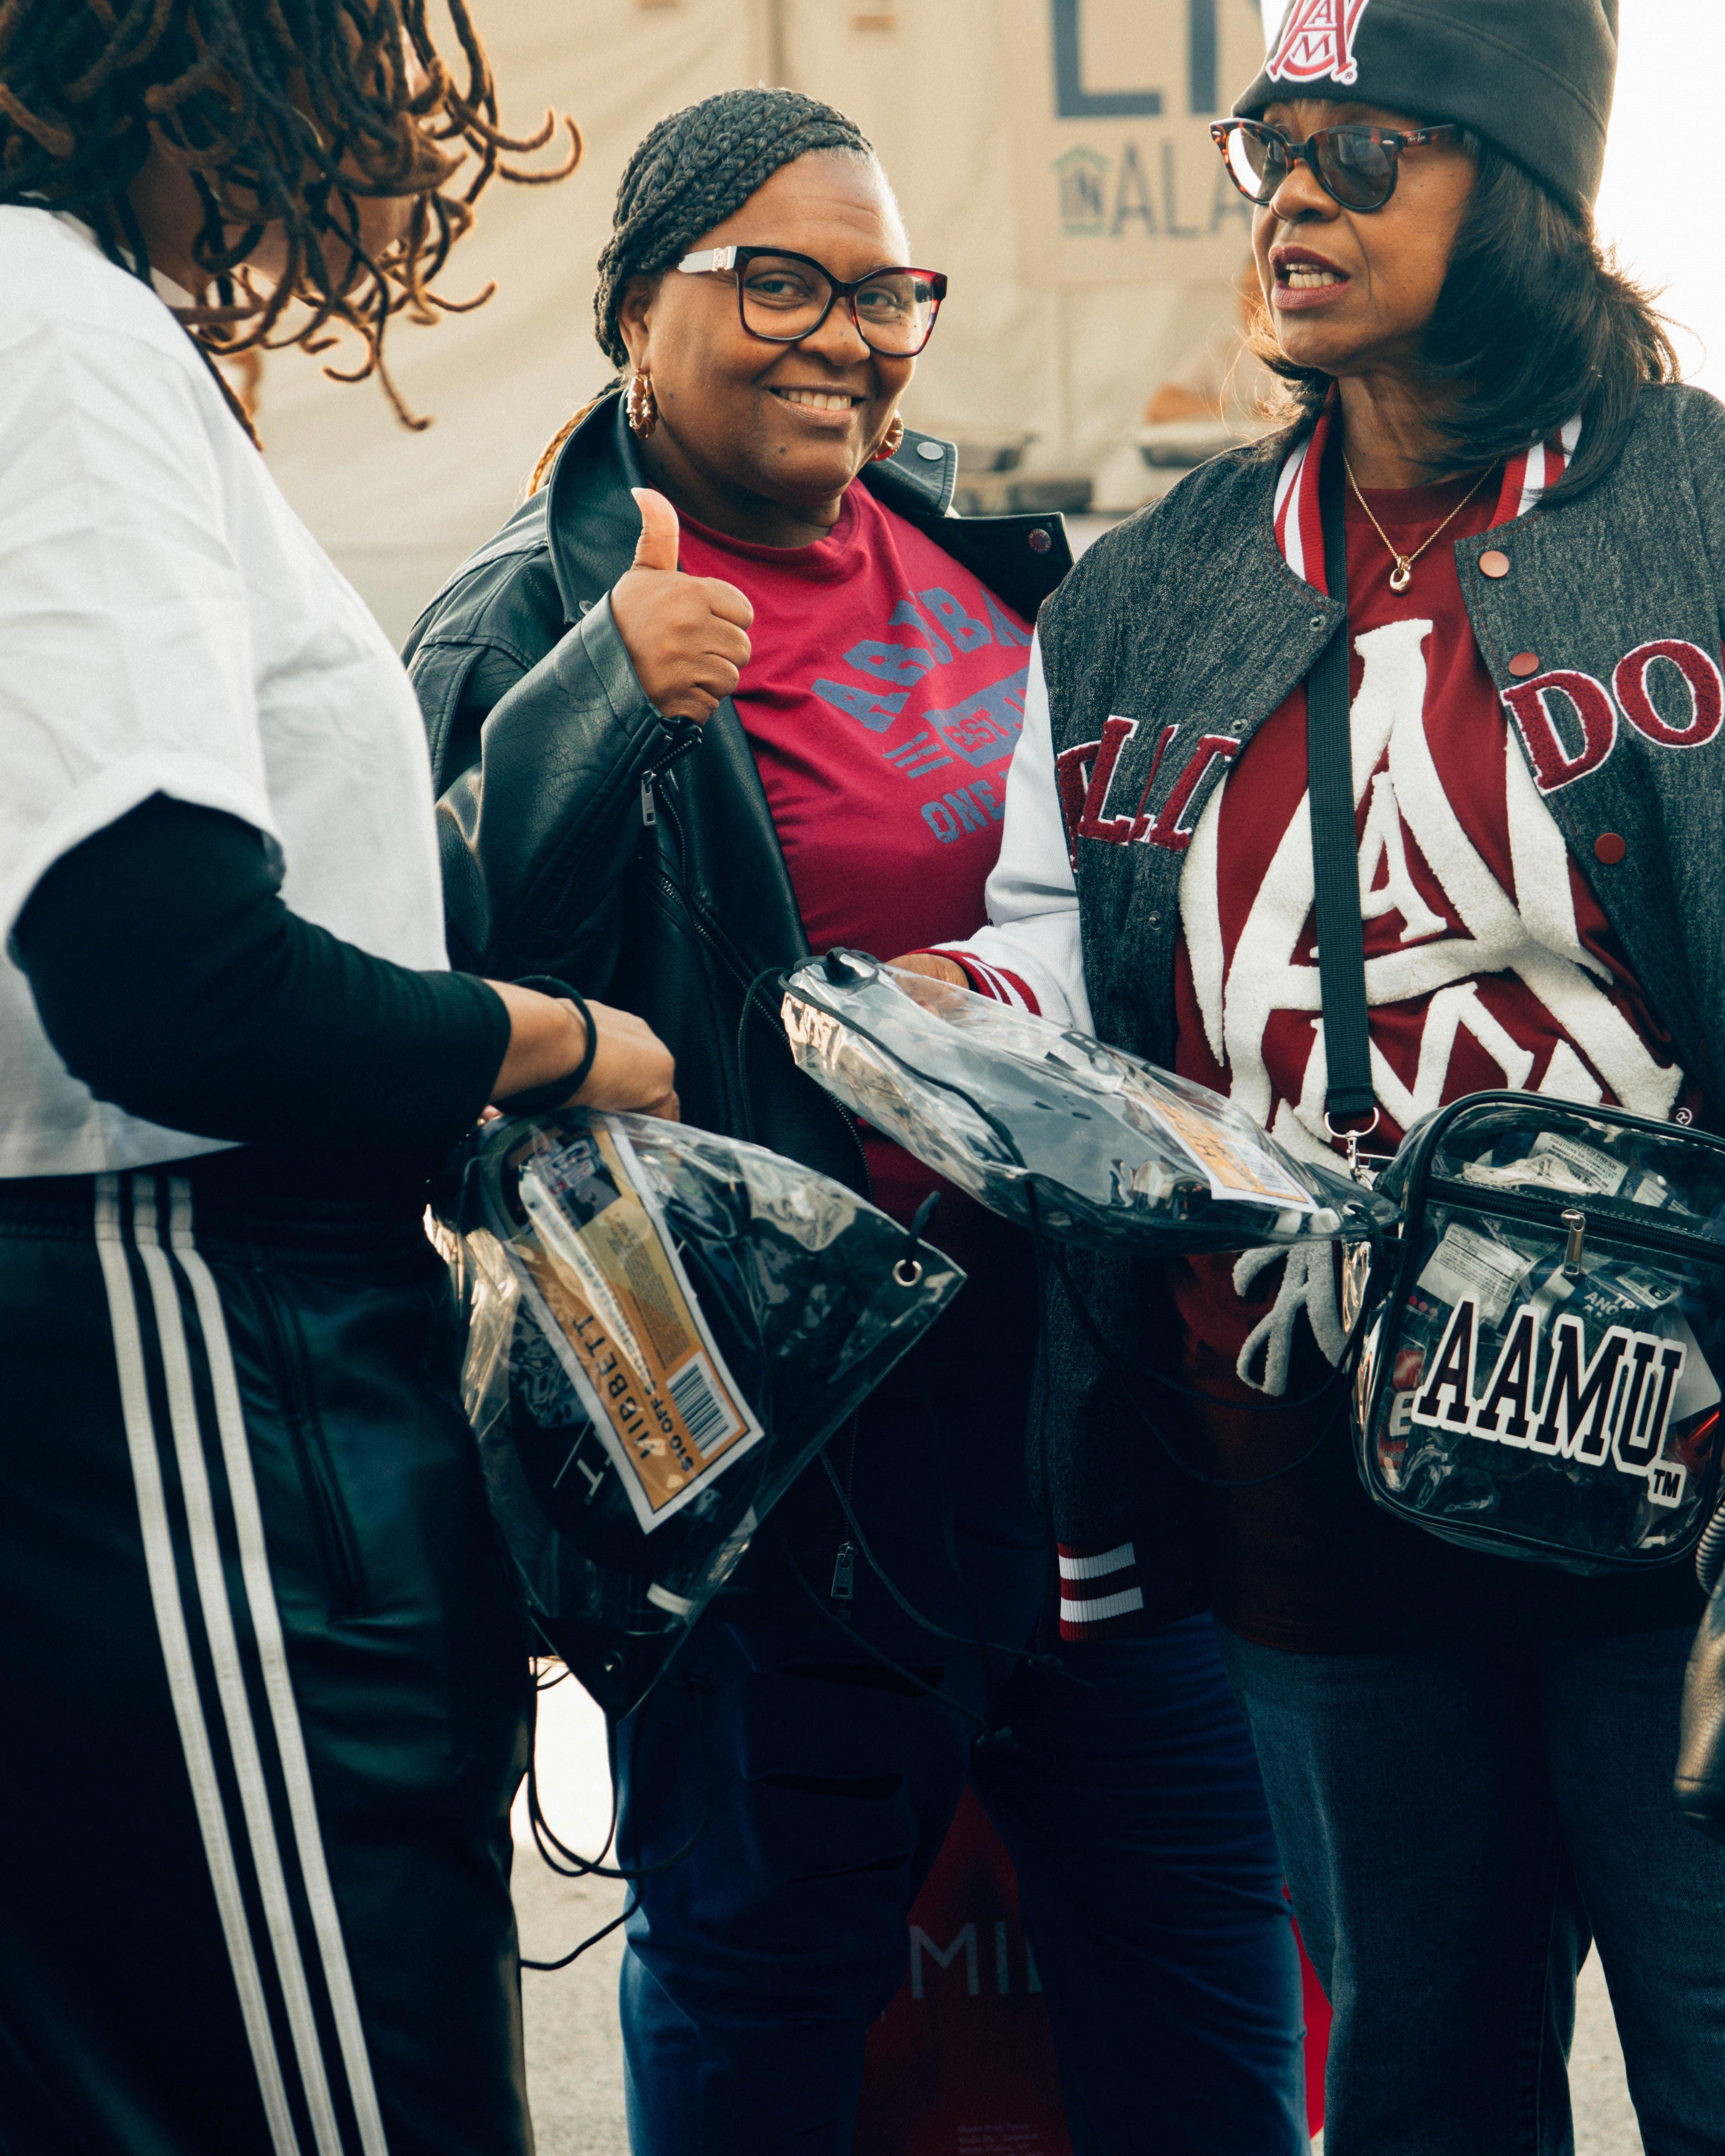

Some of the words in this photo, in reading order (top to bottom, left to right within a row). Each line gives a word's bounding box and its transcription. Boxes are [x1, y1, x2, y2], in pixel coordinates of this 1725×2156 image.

[572, 1314, 655, 1460] HIBBETT
[1414, 1295, 1686, 1475] AAMU
[651, 1397, 674, 1434] OFF
[670, 1433, 695, 1472] $10
[1653, 1469, 1682, 1499] TM
